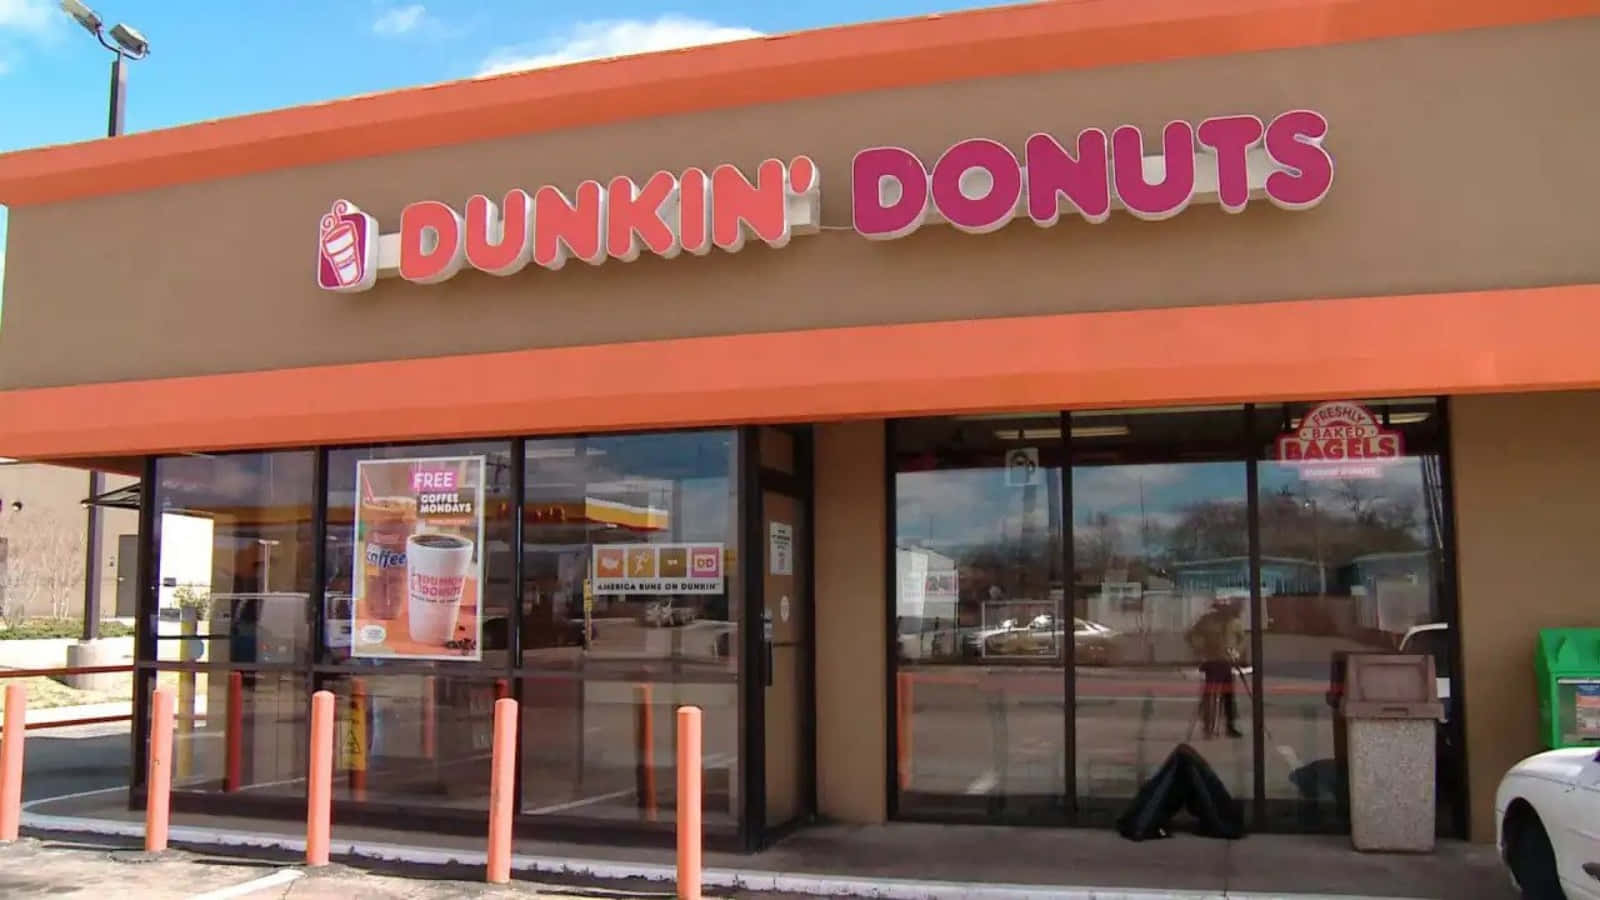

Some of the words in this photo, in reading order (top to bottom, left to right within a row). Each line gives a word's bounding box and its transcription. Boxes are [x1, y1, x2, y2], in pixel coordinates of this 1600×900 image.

[400, 156, 817, 282] DUNKIN'
[853, 109, 1334, 239] DONUTS
[1312, 405, 1366, 424] FRESHLY
[1313, 426, 1365, 438] BAKED
[1284, 437, 1396, 460] BAGELS
[414, 471, 454, 488] FREE
[420, 493, 459, 503] COFFEE
[420, 502, 472, 513] MONDAYS
[598, 583, 636, 591] AMERICA
[639, 583, 661, 591] RUNS
[665, 583, 678, 591] ON
